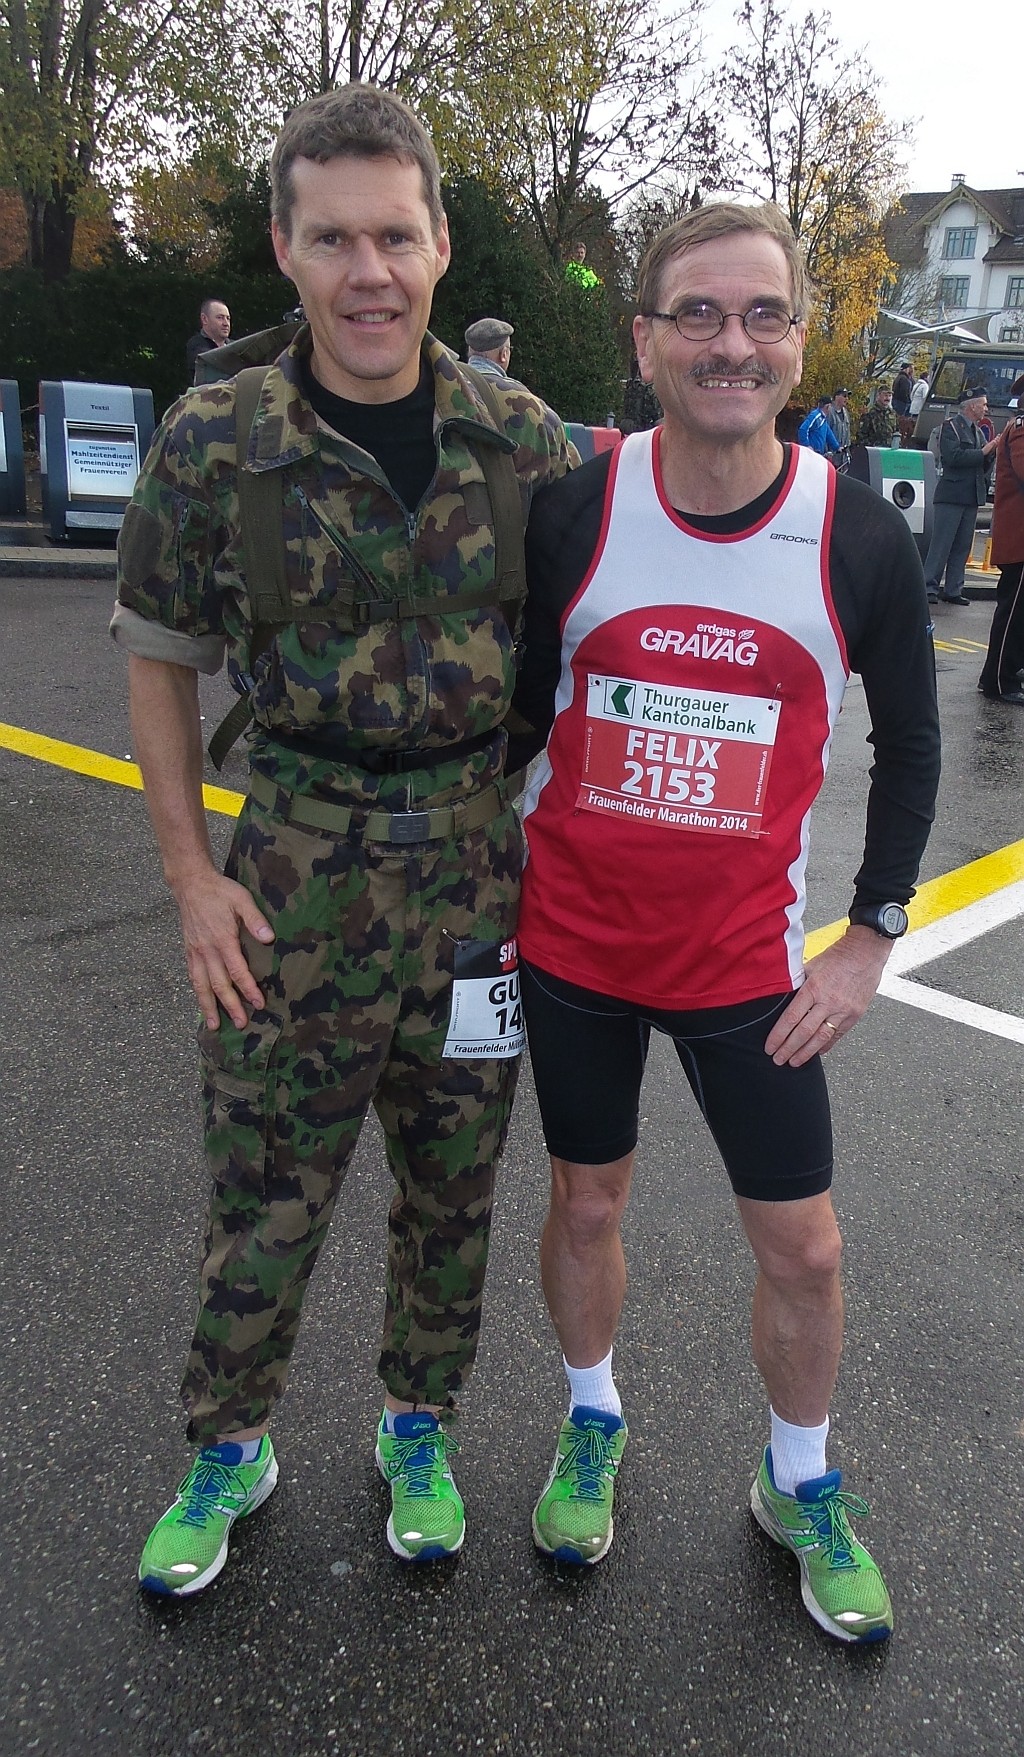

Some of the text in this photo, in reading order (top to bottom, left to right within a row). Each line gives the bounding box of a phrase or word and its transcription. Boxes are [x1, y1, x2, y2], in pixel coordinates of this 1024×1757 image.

[71, 450, 134, 460] Mahlzeitendienst
[74, 458, 132, 469] Gemeinnütziger
[80, 467, 128, 476] Frauenverein
[770, 533, 818, 545] BROOKS
[696, 623, 737, 637] erdgas
[640, 627, 759, 666] GRAVAG
[643, 688, 729, 713] Thurgauer
[642, 705, 757, 734] Kantonalbank
[626, 728, 722, 770] FELIX
[620, 760, 716, 805] 2153
[588, 790, 748, 831] Frauenfelder Marathon 2014
[495, 1002, 525, 1036] 14
[454, 1043, 508, 1053] Frauenfelder
